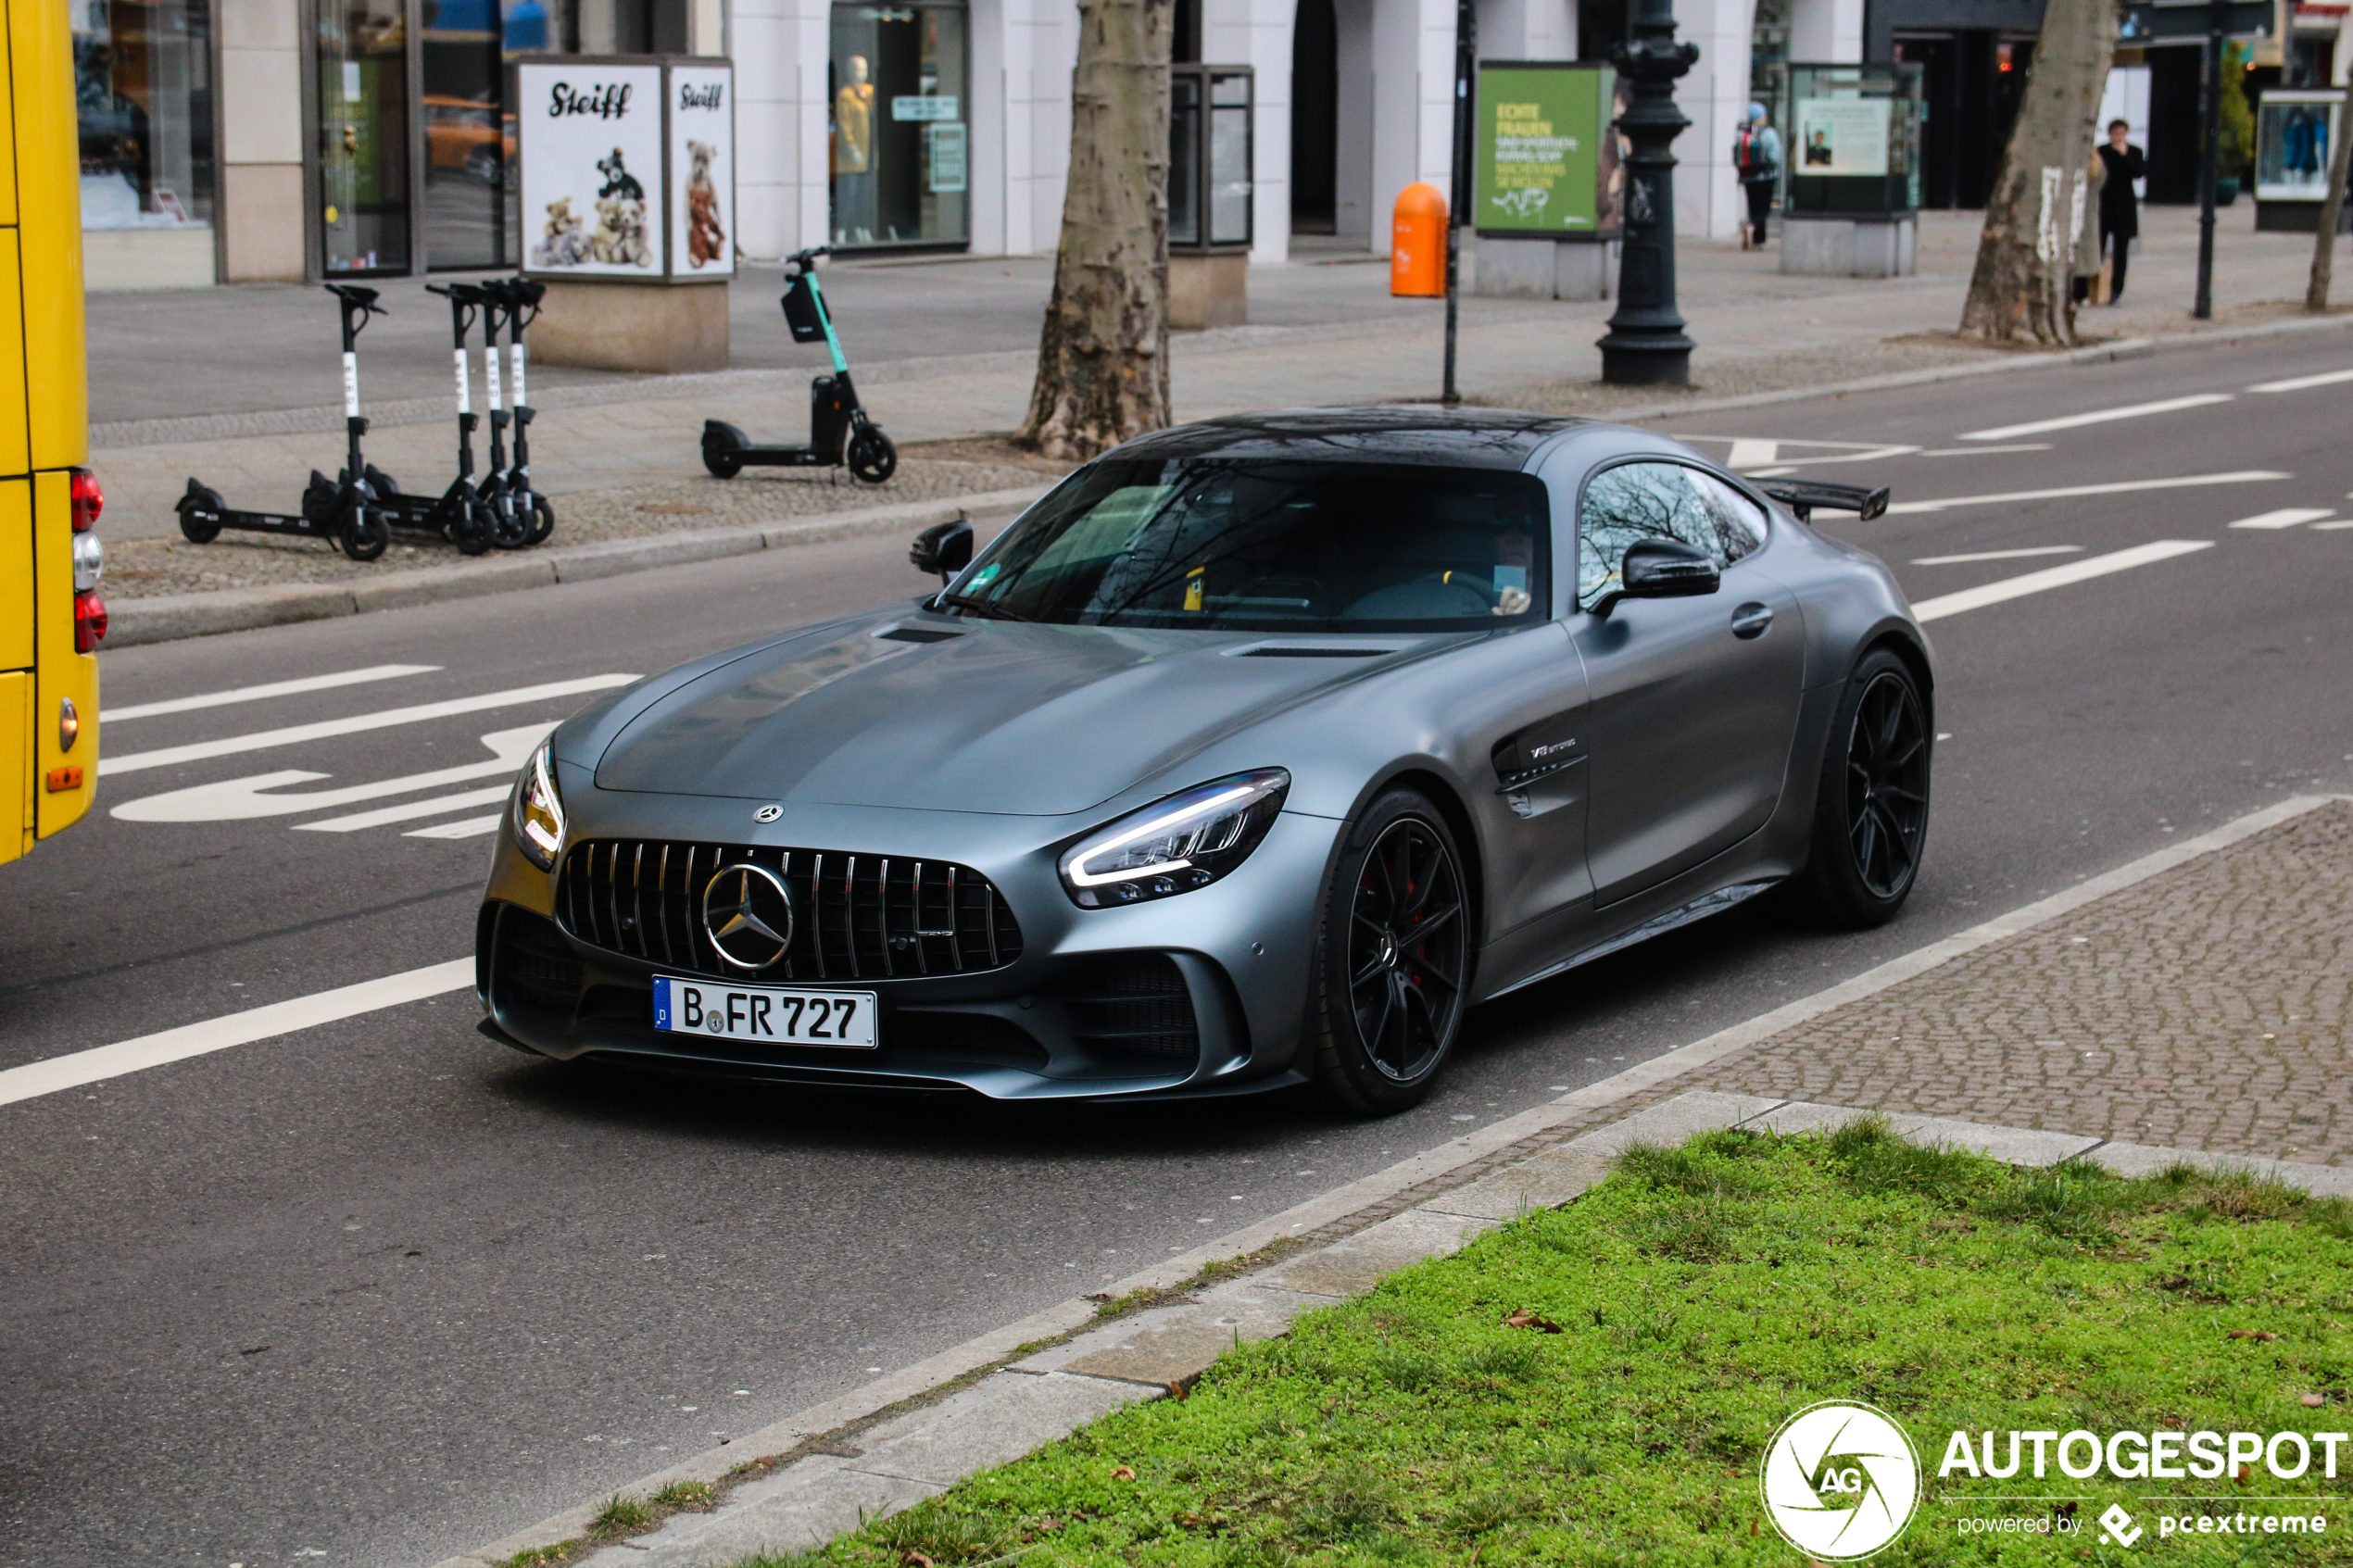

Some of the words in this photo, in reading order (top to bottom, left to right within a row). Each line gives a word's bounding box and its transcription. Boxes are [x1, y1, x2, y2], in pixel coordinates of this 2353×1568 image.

[548, 82, 633, 120] Steiff
[680, 82, 724, 112] Steiff
[1496, 103, 1540, 119] ECHTE
[659, 1009, 666, 1021] D
[684, 986, 704, 1028] B
[726, 992, 774, 1036] FR
[783, 996, 857, 1039] 727
